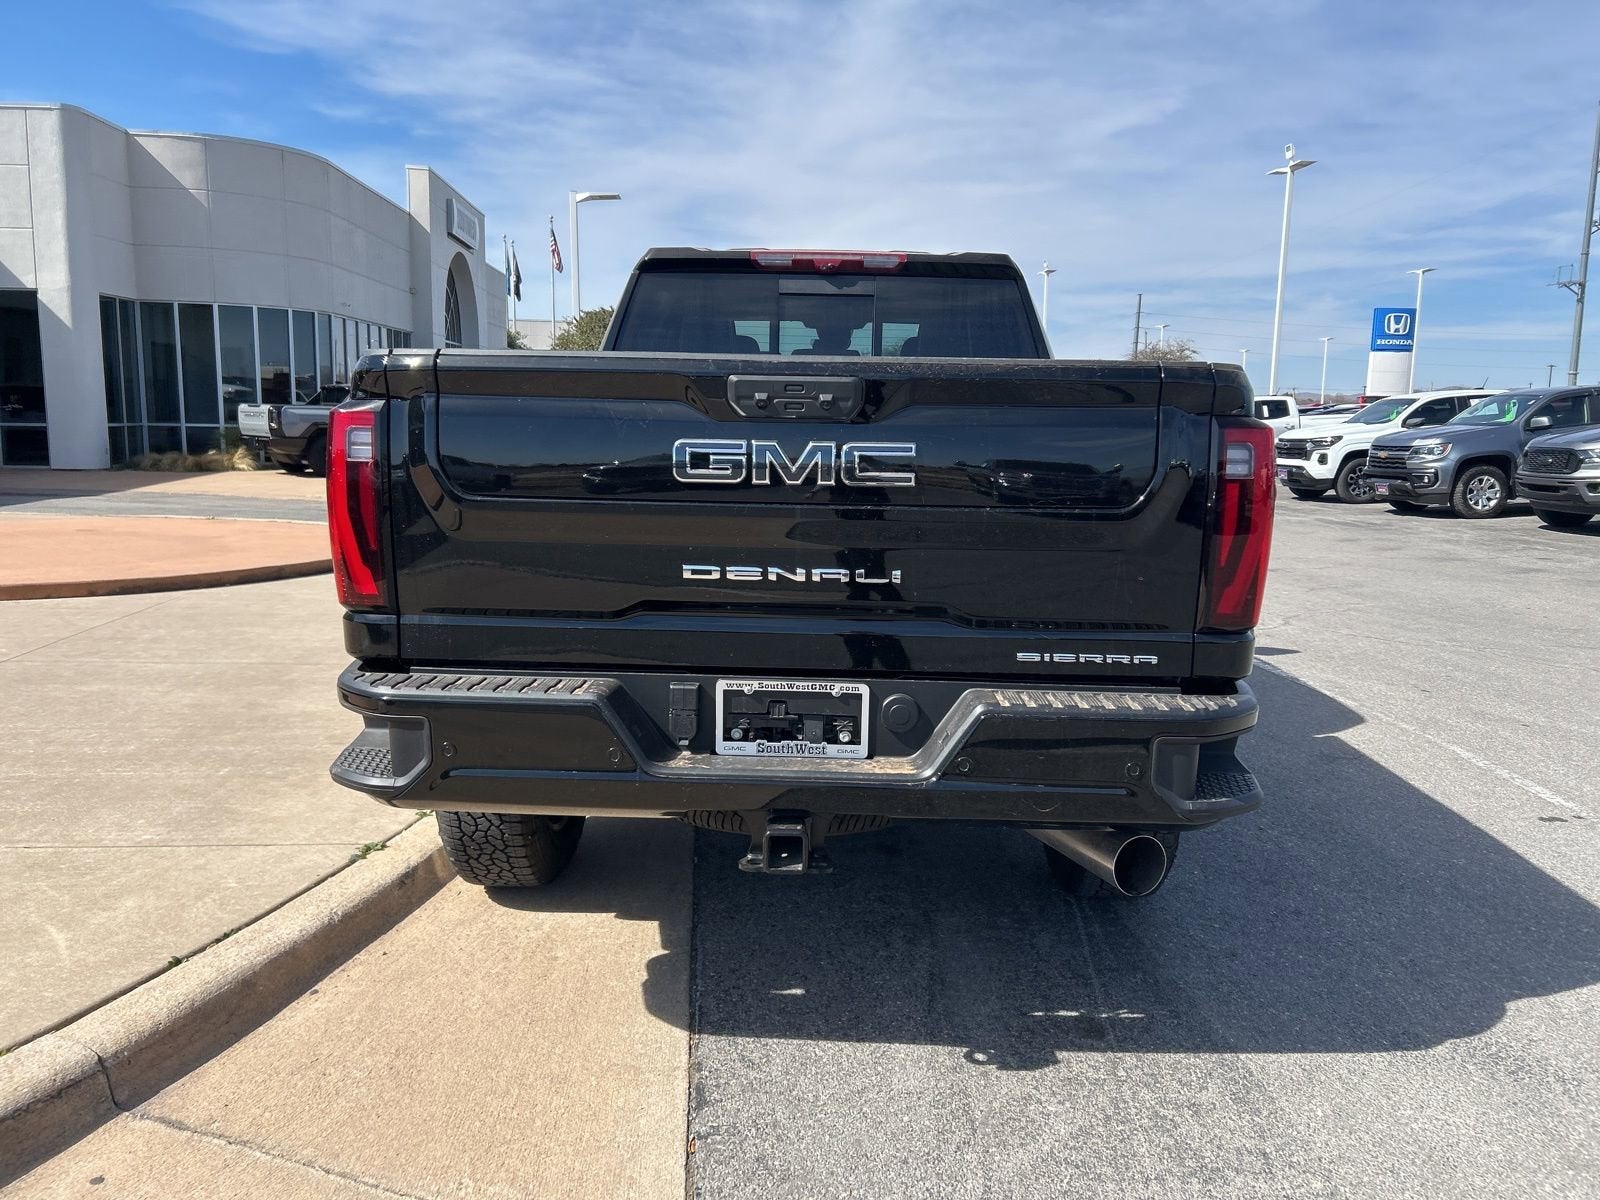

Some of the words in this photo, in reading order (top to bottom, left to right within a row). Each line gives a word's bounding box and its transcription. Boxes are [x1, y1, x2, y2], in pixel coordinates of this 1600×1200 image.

[673, 438, 917, 487] GMC
[682, 564, 902, 584] DENALI
[1016, 652, 1158, 665] SIERRA
[725, 682, 860, 692] www.SouthWestGMCcom
[757, 743, 828, 755] SouthWest
